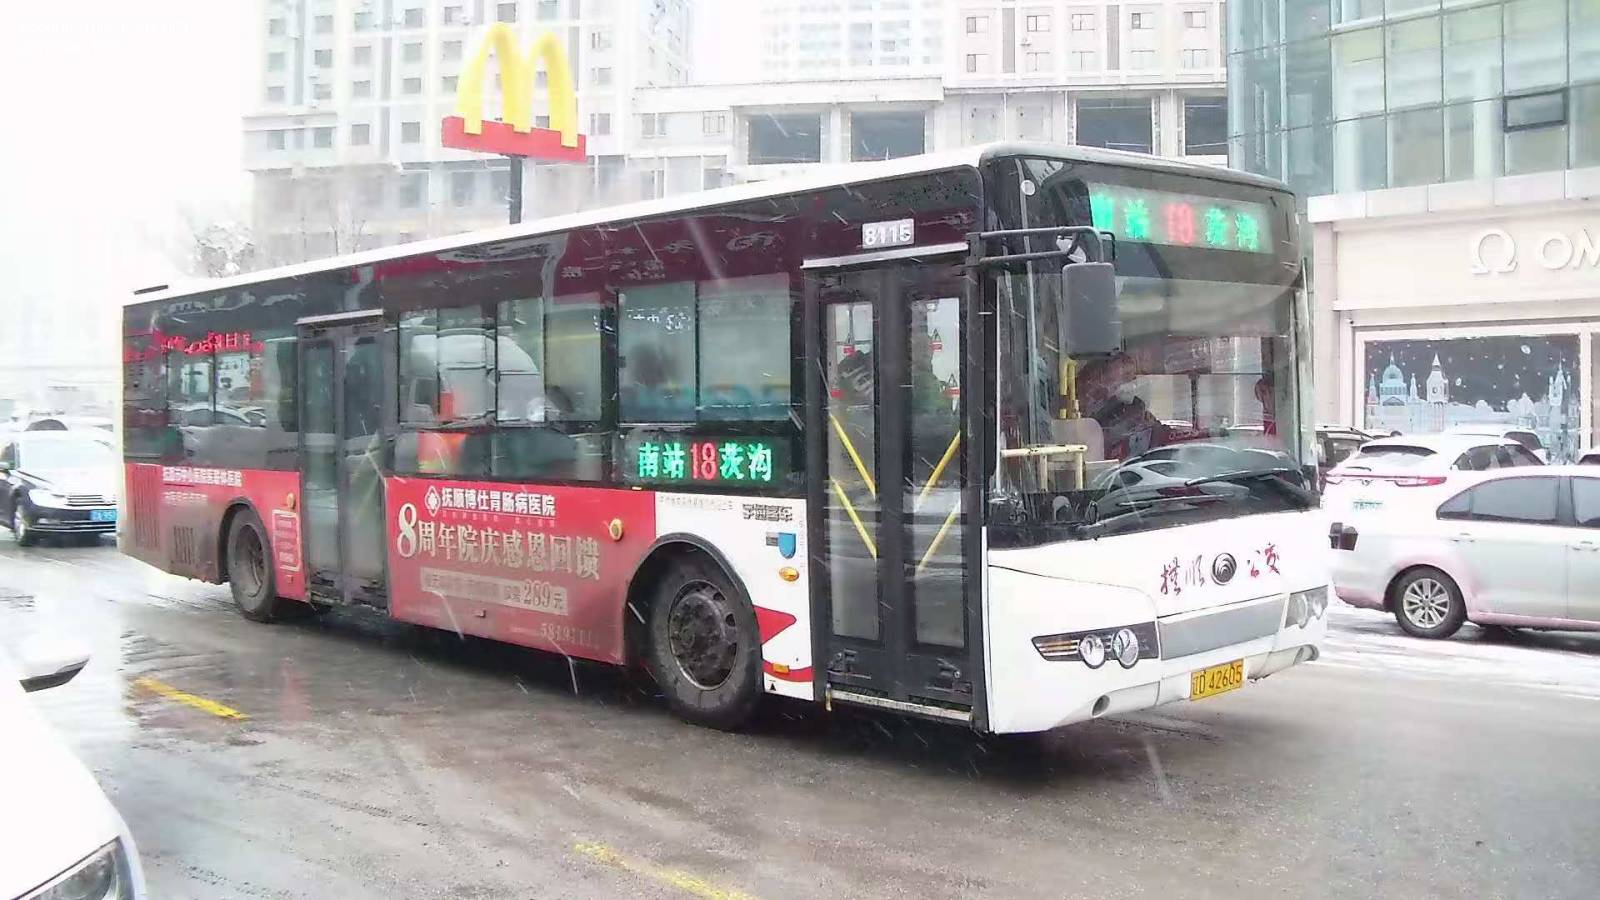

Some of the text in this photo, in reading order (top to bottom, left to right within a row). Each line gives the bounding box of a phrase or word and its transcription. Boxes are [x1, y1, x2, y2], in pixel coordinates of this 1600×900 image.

[864, 224, 913, 246] 8115
[637, 442, 685, 479] 南站
[691, 442, 717, 480] 18
